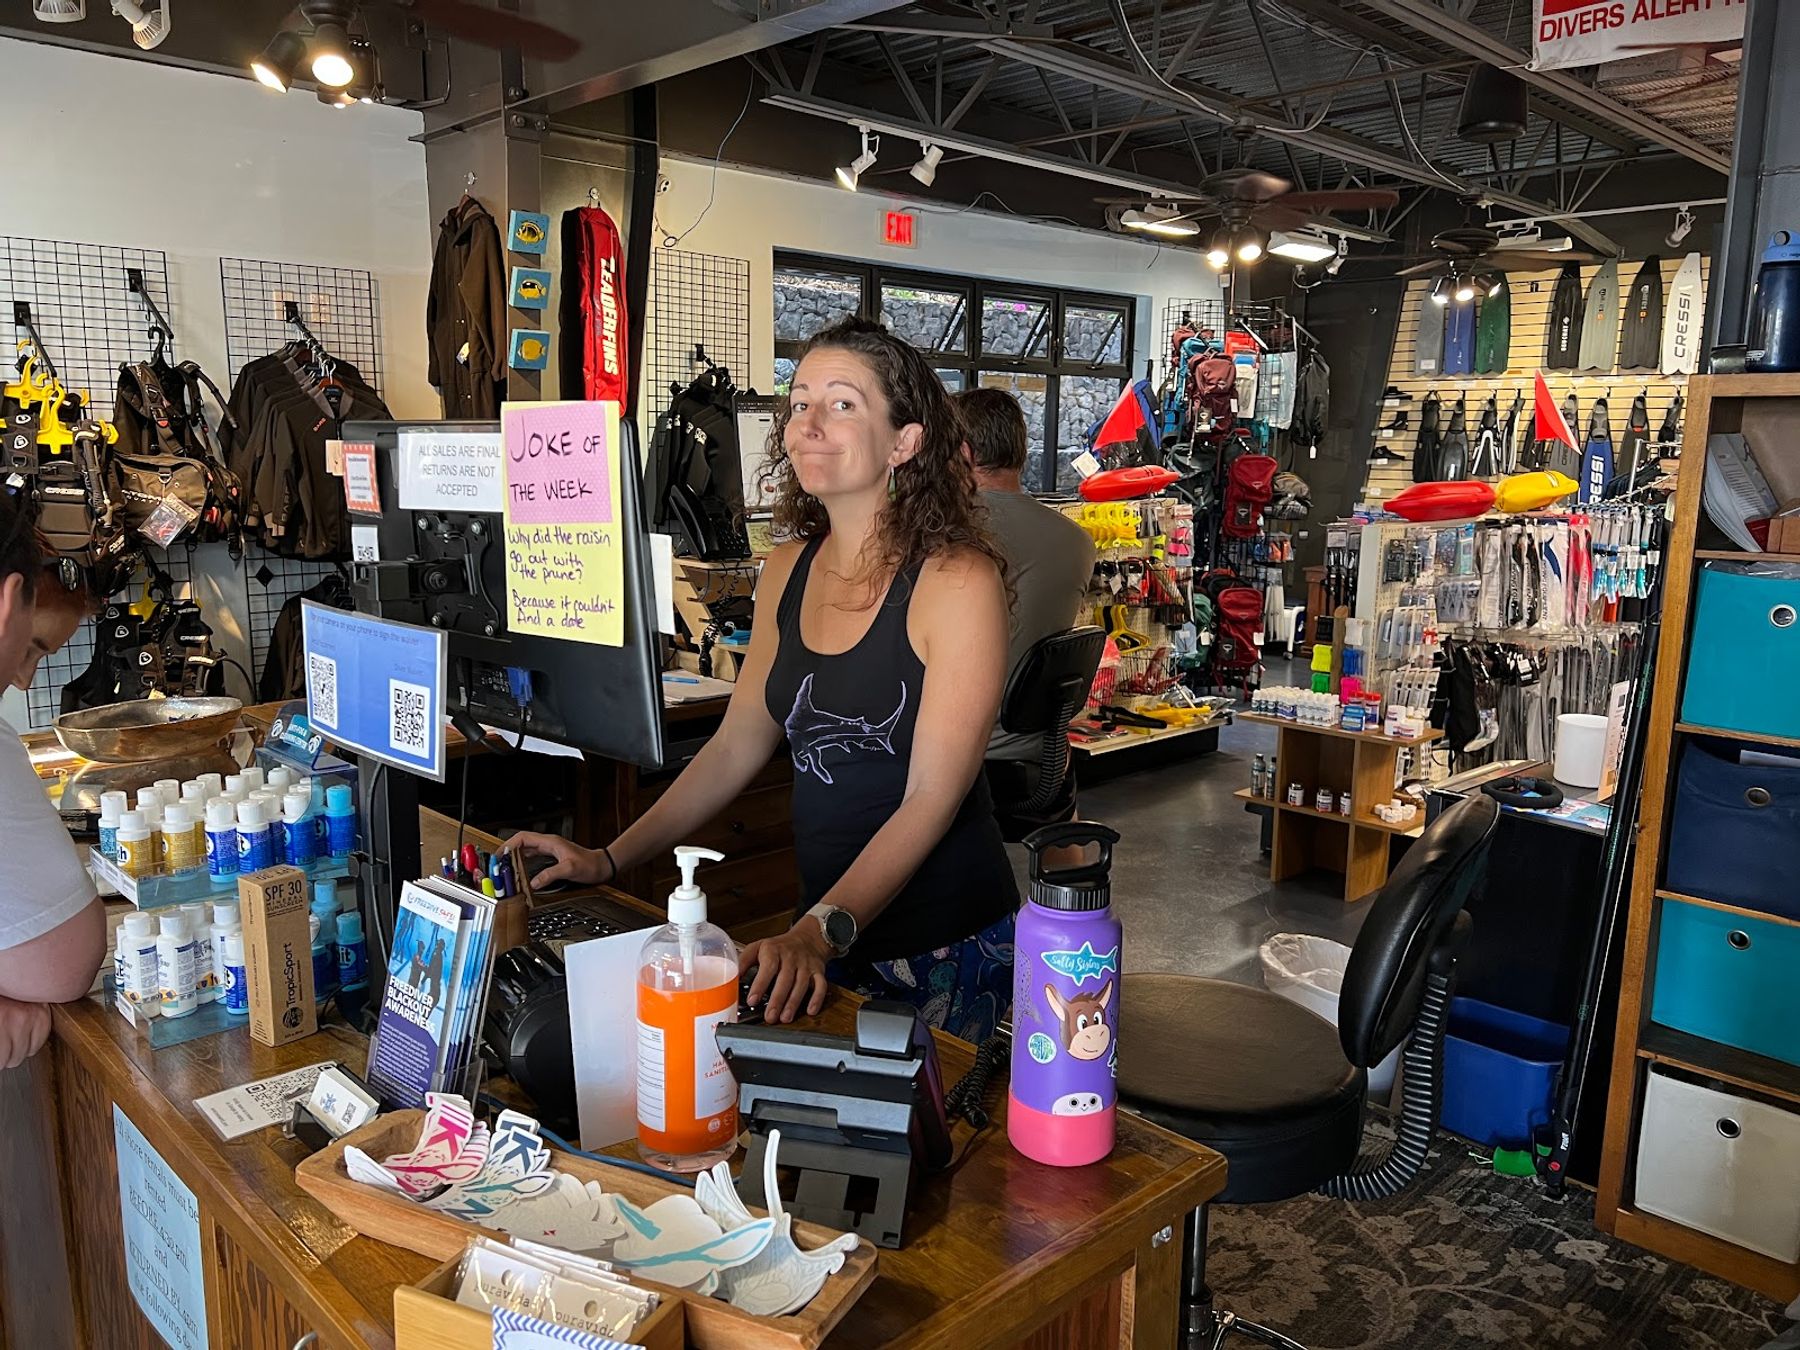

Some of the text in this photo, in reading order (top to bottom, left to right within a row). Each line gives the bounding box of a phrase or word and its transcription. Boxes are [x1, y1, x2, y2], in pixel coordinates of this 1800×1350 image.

[1539, 3, 1625, 42] DIVERS
[600, 255, 619, 376] LEADERFINS
[1674, 291, 1691, 358] CRESSI
[419, 445, 500, 458] ALL SALES ARE FINAL
[510, 415, 601, 462] JOKE OF
[423, 464, 495, 478] RETURNS ARE NOT
[1589, 455, 1605, 504] RESSI
[436, 484, 478, 497] ACCEPTED
[510, 478, 592, 503] THE WEEK
[533, 526, 552, 544] did
[554, 525, 573, 545] the
[576, 530, 611, 547] raisin
[510, 549, 584, 572] go out with
[520, 564, 582, 585] the prune?
[512, 589, 556, 608] Because
[560, 595, 571, 610] it
[547, 616, 555, 627] a
[561, 612, 585, 629] date
[265, 879, 302, 902] SPF 30
[283, 942, 296, 1008] TropicSport
[387, 985, 431, 1018] BLACKOUT
[389, 975, 433, 1008] FREEDIVER
[384, 998, 436, 1034] AWARENESS
[144, 1153, 168, 1188] rentals
[168, 1180, 187, 1212] must
[188, 1198, 199, 1223] be
[145, 1178, 167, 1213] rented
[155, 1245, 167, 1268] and
[171, 1287, 180, 1311] BY
[146, 1286, 182, 1344] following
[183, 1331, 193, 1350] da
